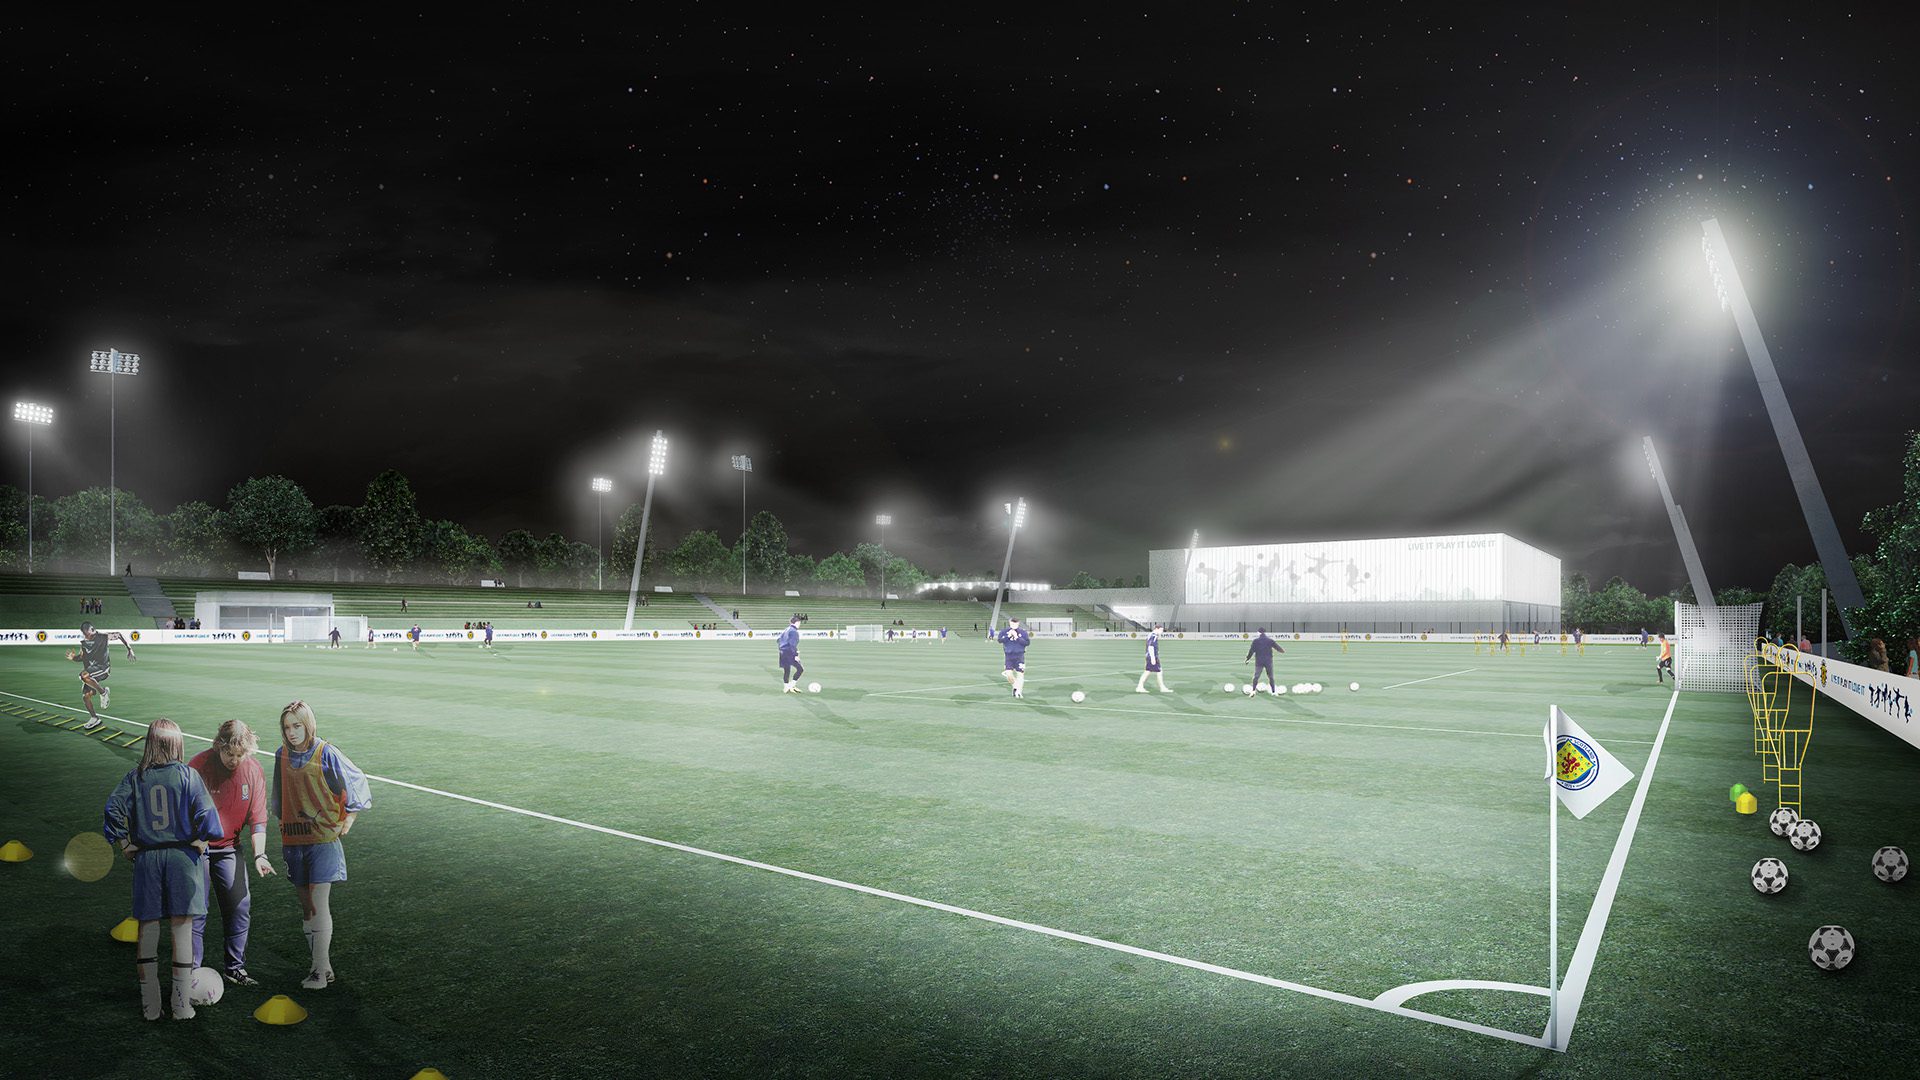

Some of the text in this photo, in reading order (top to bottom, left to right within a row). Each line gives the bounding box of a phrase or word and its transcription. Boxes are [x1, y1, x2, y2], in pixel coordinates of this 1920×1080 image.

[1408, 540, 1496, 551] LIVE IT PLAY IT LOVE IT
[149, 784, 170, 832] 9
